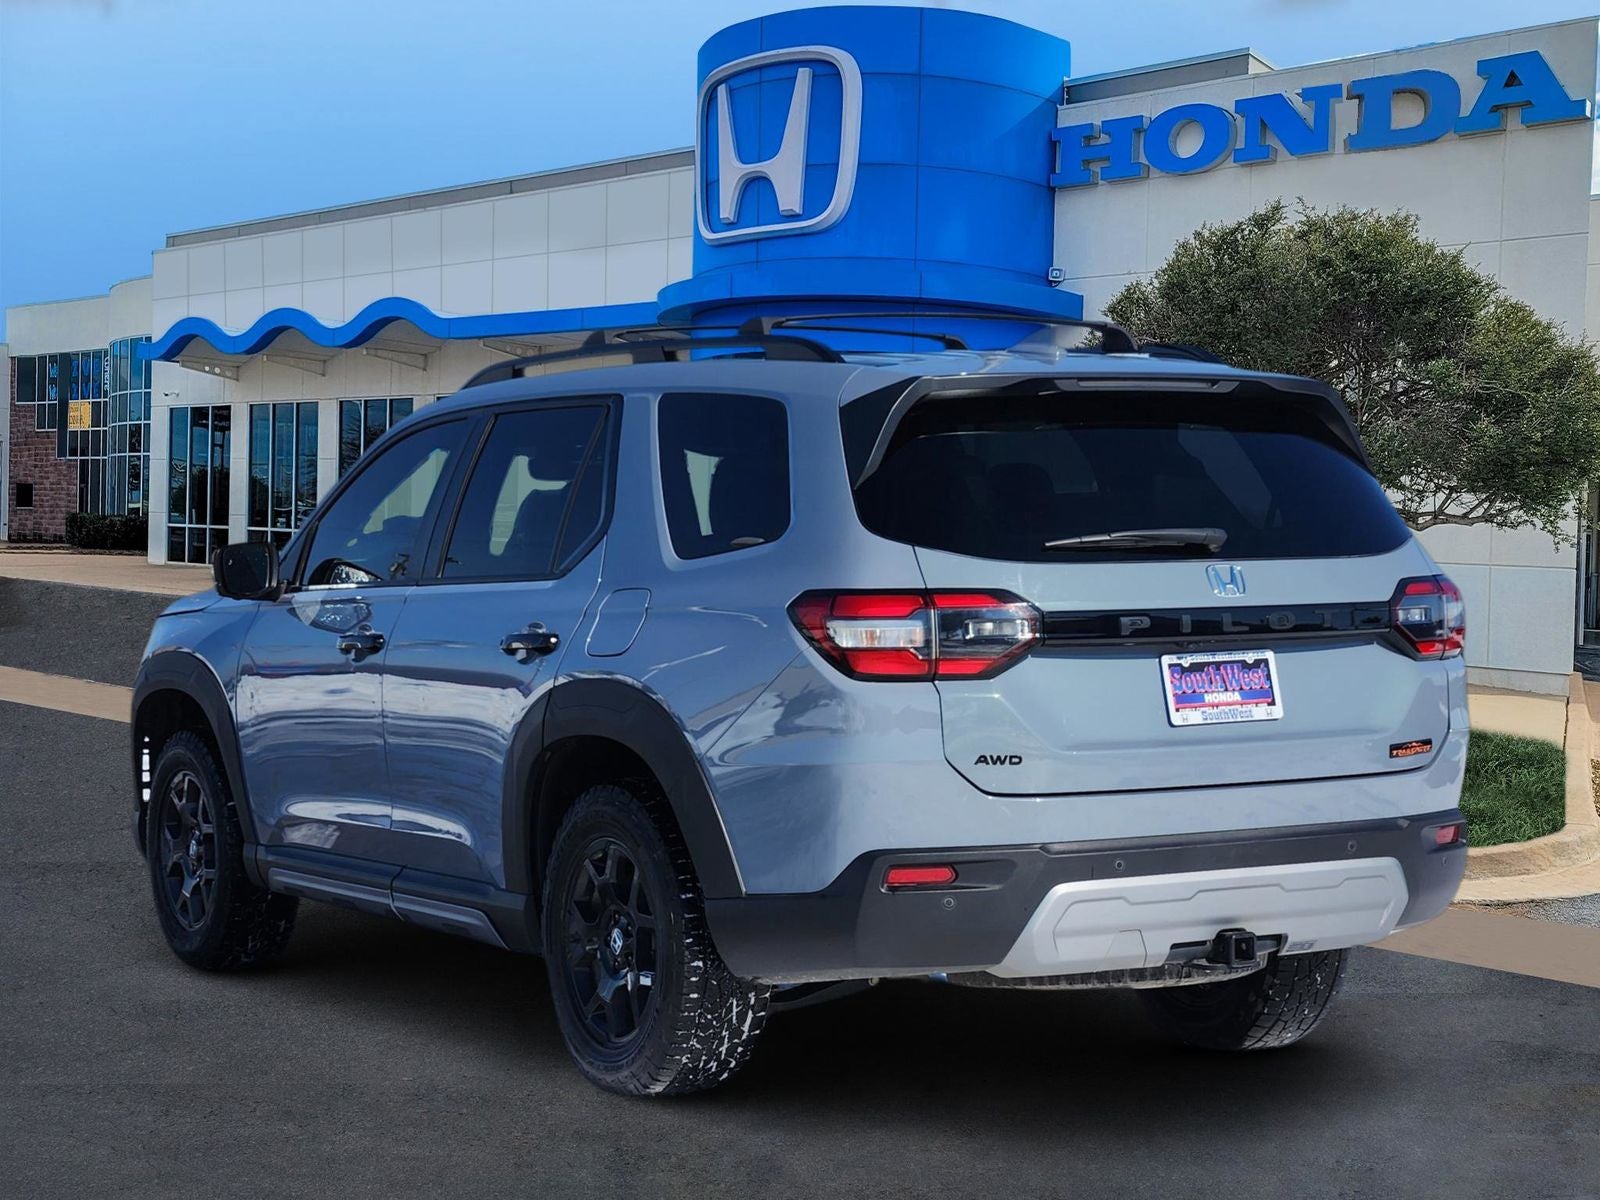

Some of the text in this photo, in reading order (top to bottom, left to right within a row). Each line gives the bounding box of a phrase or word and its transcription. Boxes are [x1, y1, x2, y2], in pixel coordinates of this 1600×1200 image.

[1051, 50, 1590, 188] HONDA
[1119, 609, 1339, 635] PILOT
[1169, 662, 1271, 694] SouthWest
[1203, 691, 1242, 703] HONDA
[1200, 708, 1254, 721] SouthWest
[974, 754, 1023, 766] AWD
